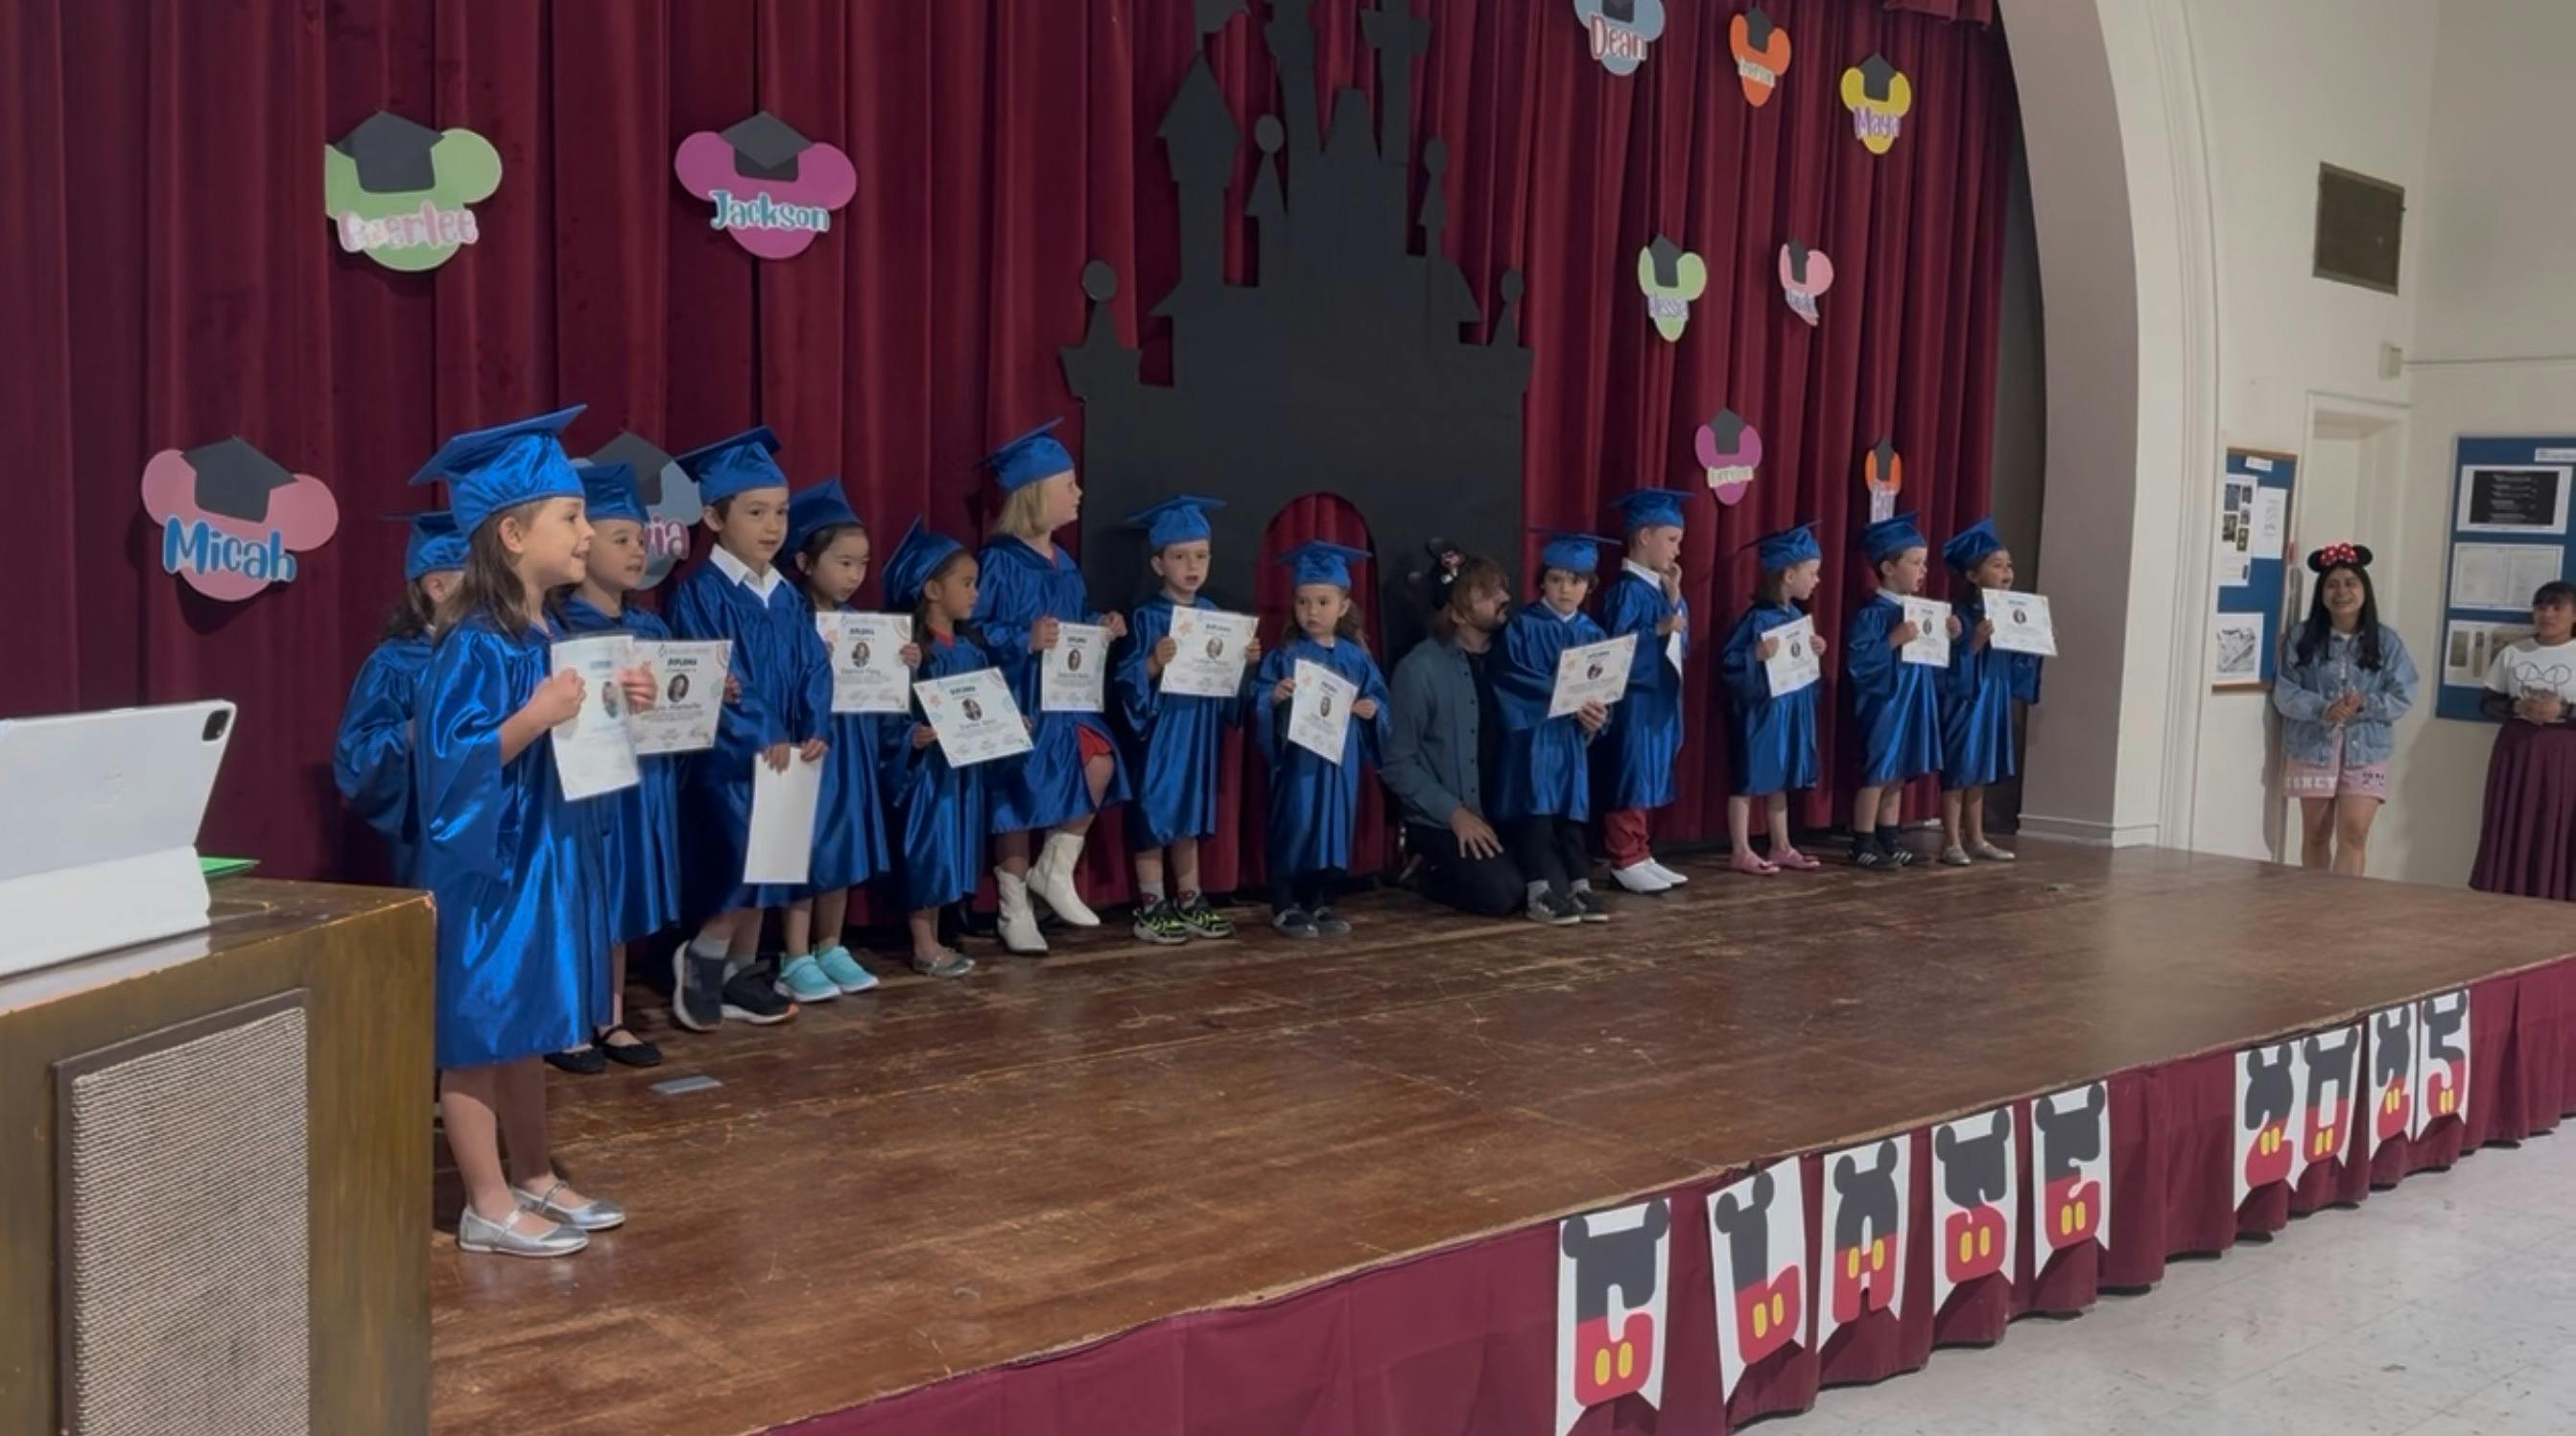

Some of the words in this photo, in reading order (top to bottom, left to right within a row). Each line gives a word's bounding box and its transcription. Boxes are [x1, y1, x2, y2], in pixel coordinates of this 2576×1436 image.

[1591, 13, 1646, 59] Dean
[711, 190, 830, 232] Jackson
[164, 515, 296, 581] Micah
[2245, 989, 2468, 1189] 2025
